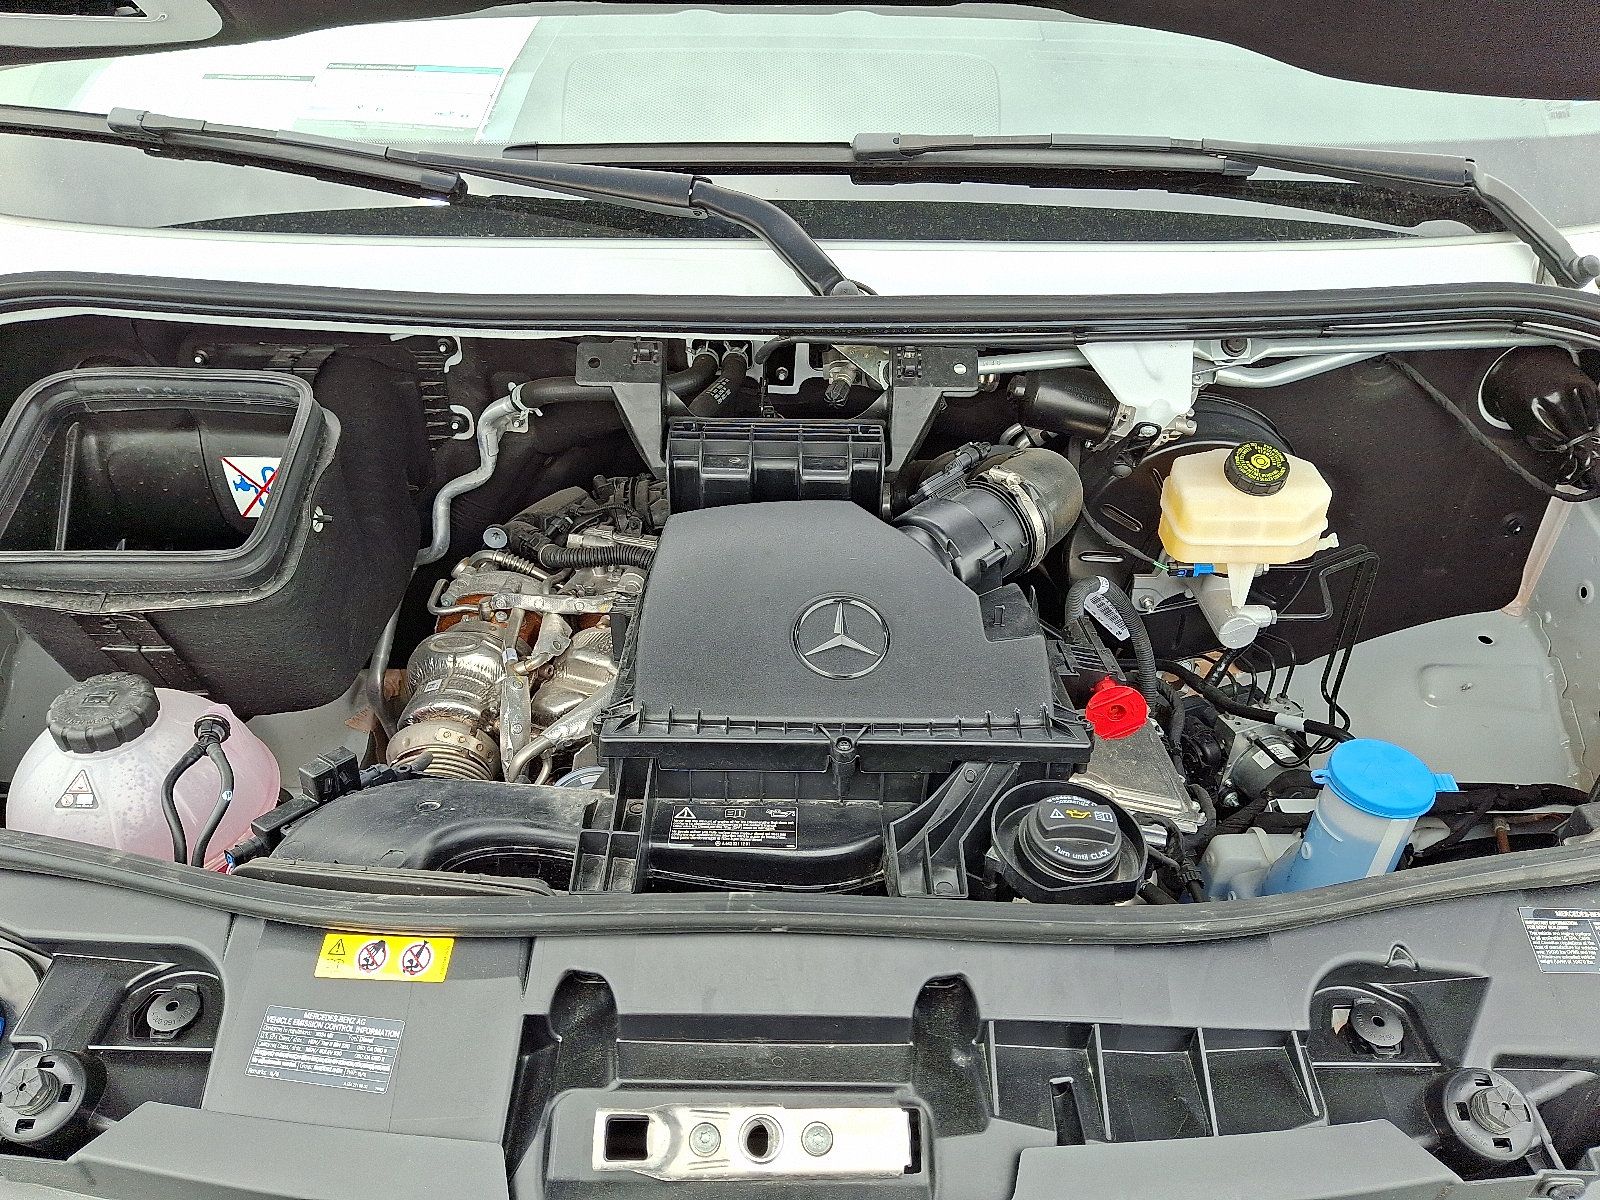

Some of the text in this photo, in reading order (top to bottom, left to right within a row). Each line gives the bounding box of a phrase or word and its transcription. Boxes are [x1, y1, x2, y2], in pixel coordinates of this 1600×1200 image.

[1054, 846, 1111, 861] Turn until CLICK
[303, 1011, 366, 1026] MERCEDES-BENZ AG
[266, 1015, 401, 1039] VEHICLE EMISSION CONTROL INFORMATION
